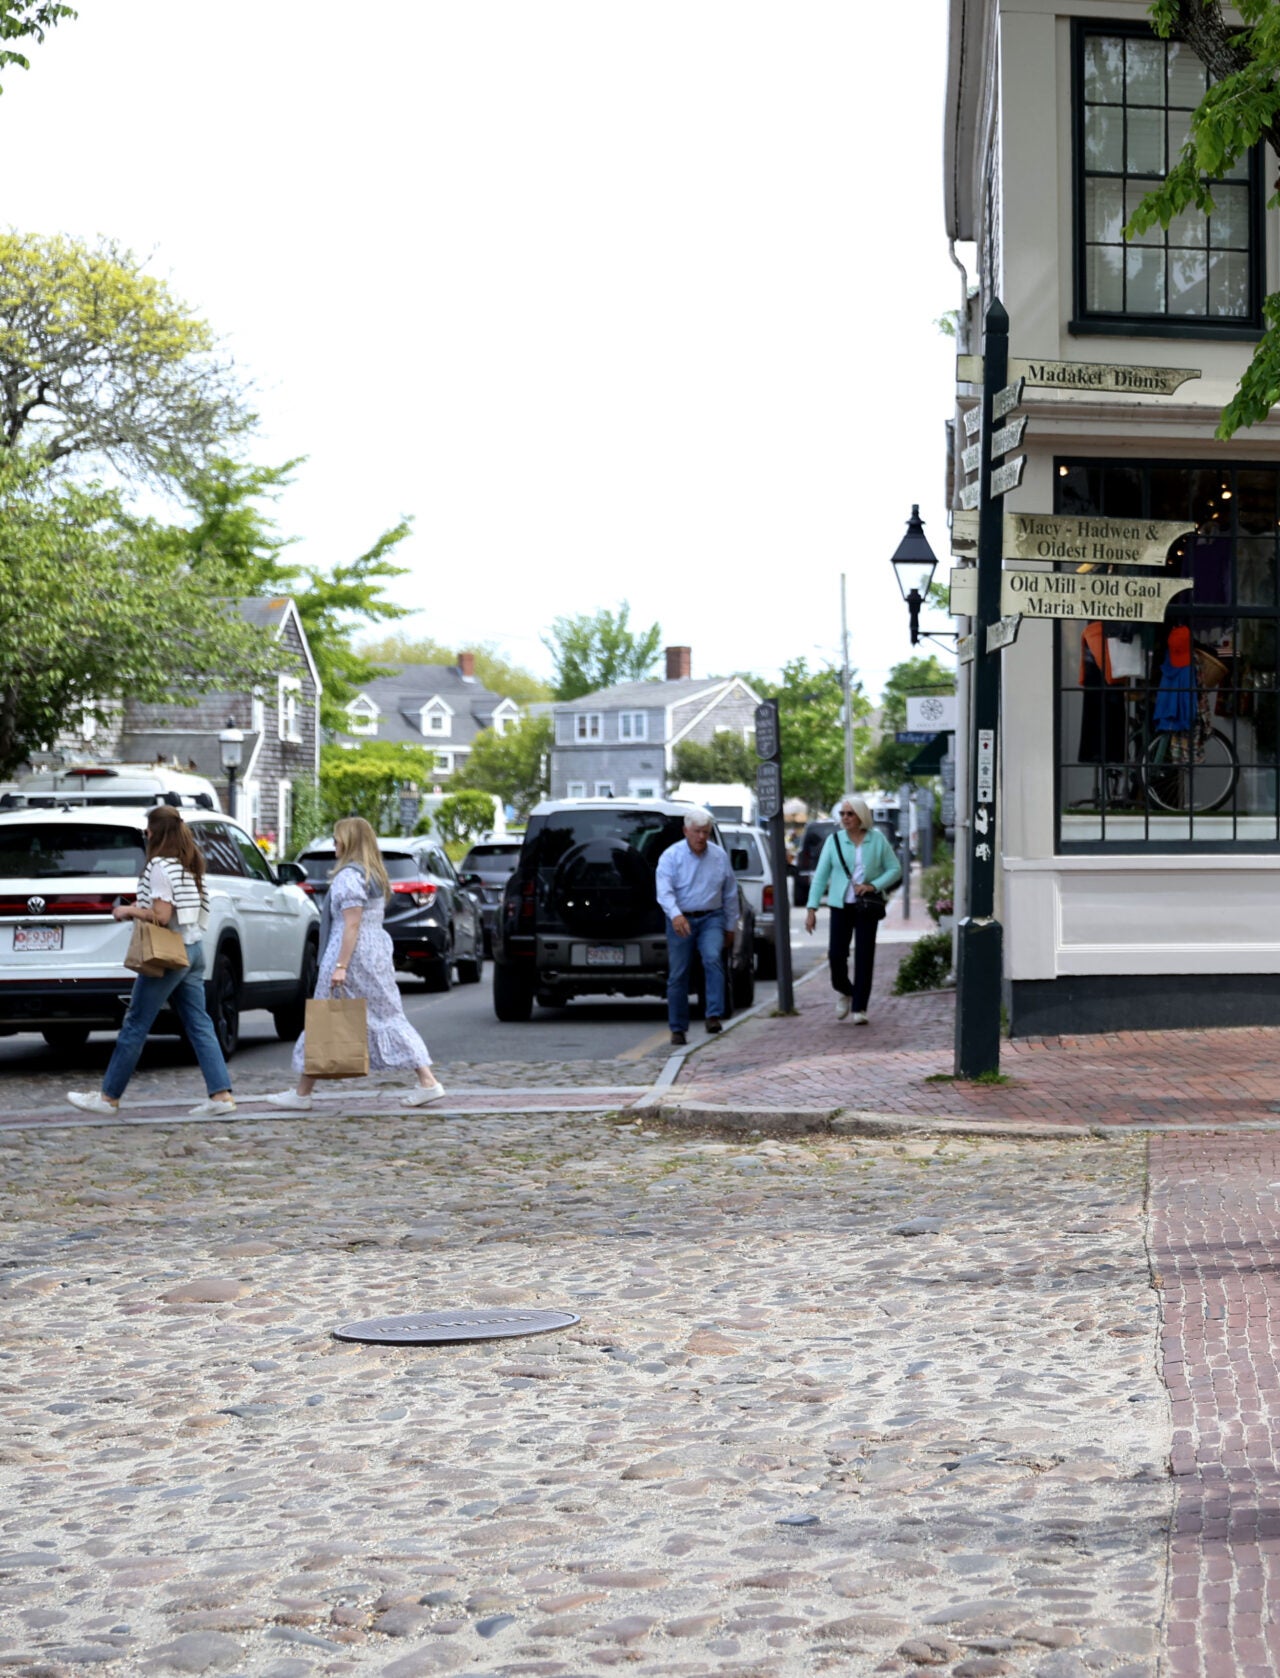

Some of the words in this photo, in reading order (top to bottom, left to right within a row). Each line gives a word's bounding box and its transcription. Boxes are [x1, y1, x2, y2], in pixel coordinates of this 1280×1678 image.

[1027, 364, 1102, 385] Madaket
[1113, 369, 1168, 389] Dionis
[1019, 517, 1062, 537] Macy
[1077, 521, 1140, 540] Hadwen
[1145, 525, 1159, 541] &
[1037, 540, 1087, 559] Oldest
[1092, 543, 1140, 561] House
[1010, 575, 1038, 593] Old
[1044, 576, 1076, 594] Mill
[1091, 578, 1119, 596] Old
[1124, 580, 1161, 598] Gaol
[1027, 597, 1074, 616] Maria
[1080, 600, 1143, 619] Mitchell
